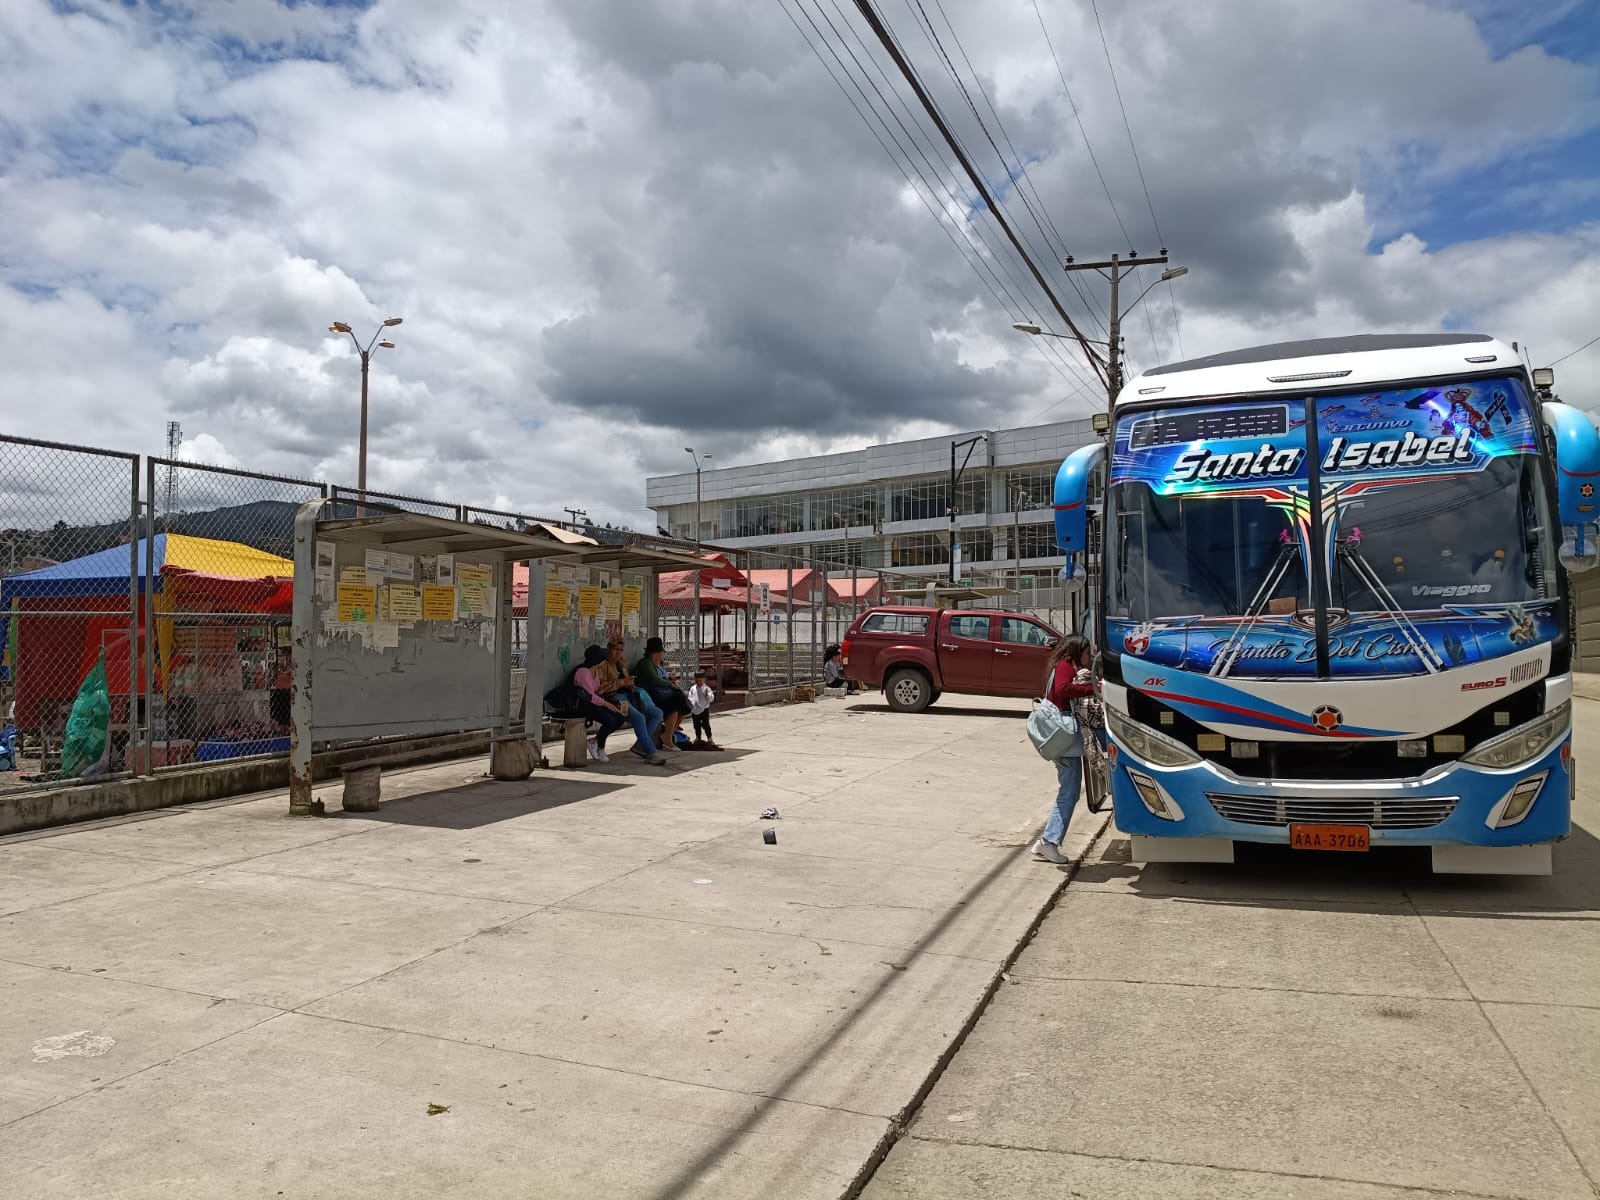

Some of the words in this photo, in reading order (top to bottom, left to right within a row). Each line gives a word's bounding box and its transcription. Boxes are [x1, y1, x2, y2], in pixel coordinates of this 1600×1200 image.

[1165, 443, 1304, 482] Santa
[1323, 428, 1473, 470] Isabel
[1411, 583, 1492, 597] Viaggio
